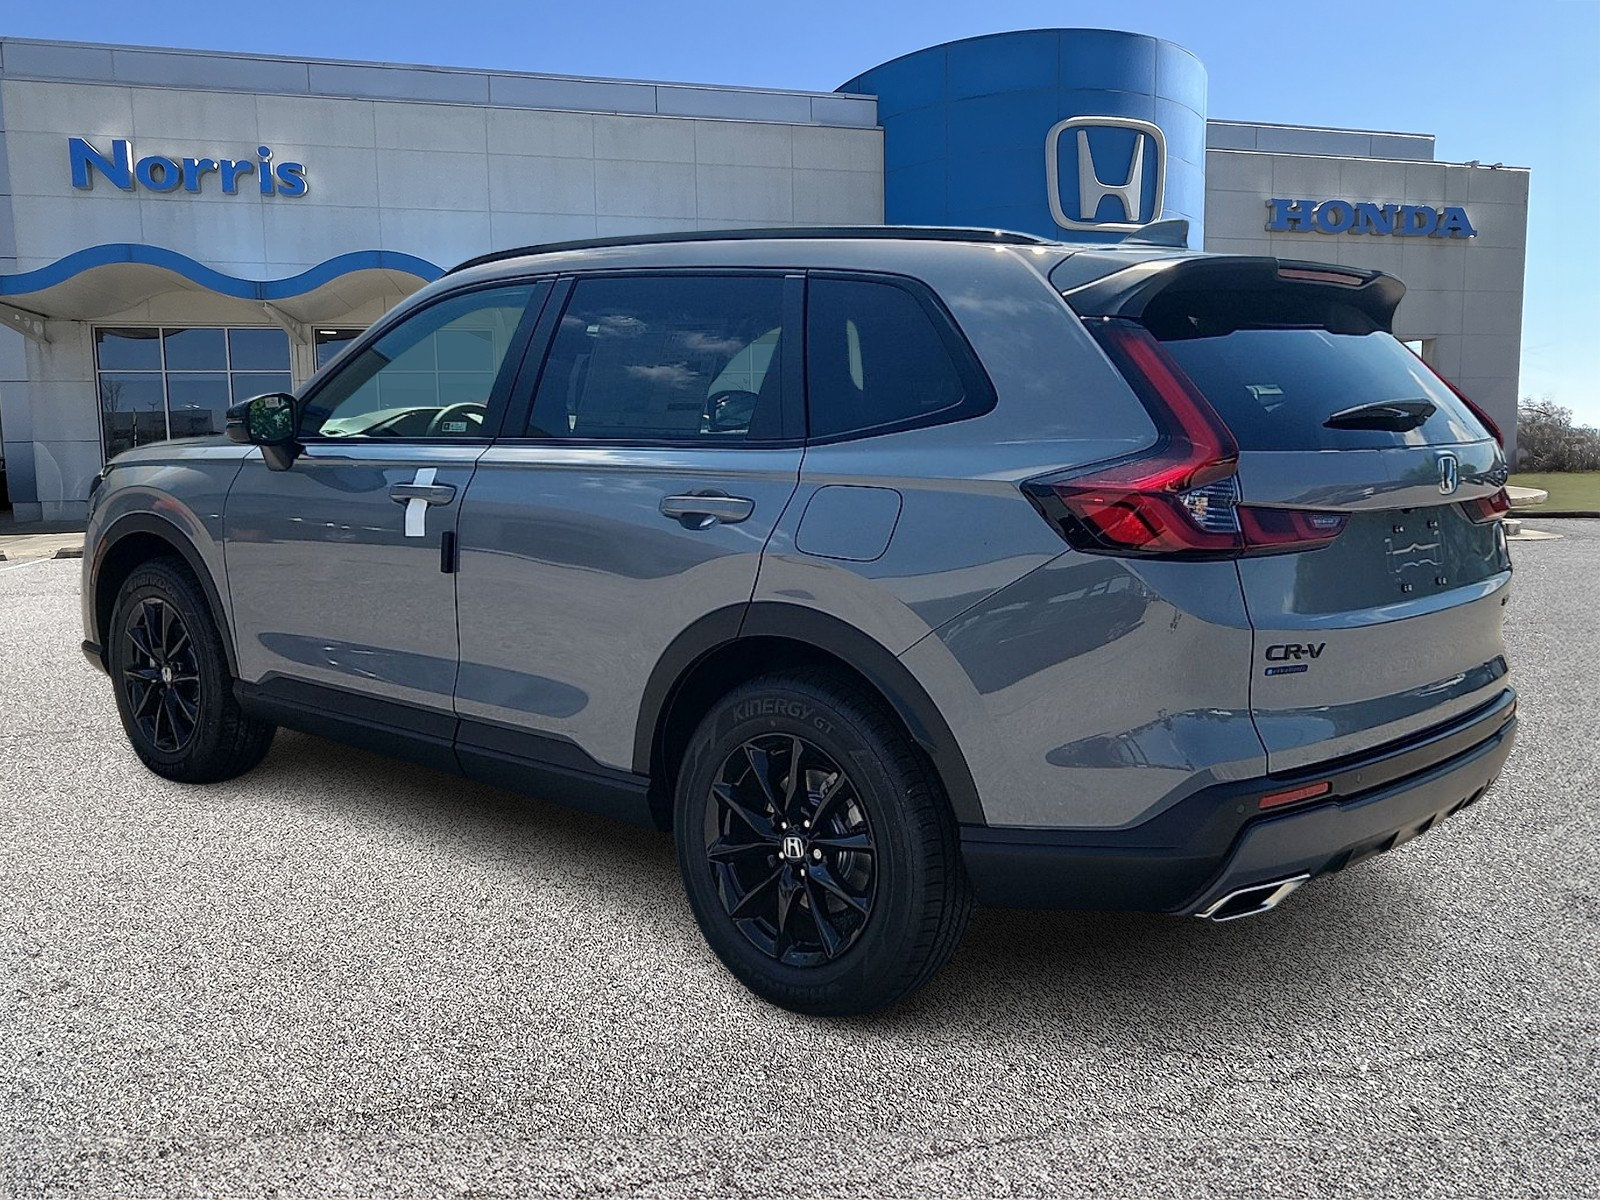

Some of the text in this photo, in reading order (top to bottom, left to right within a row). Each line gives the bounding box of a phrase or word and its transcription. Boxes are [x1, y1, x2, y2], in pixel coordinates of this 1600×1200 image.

[68, 137, 309, 197] Norris
[1265, 198, 1478, 239] HONDA
[1265, 642, 1327, 661] CR-V
[733, 698, 837, 734] KINERGY GT
